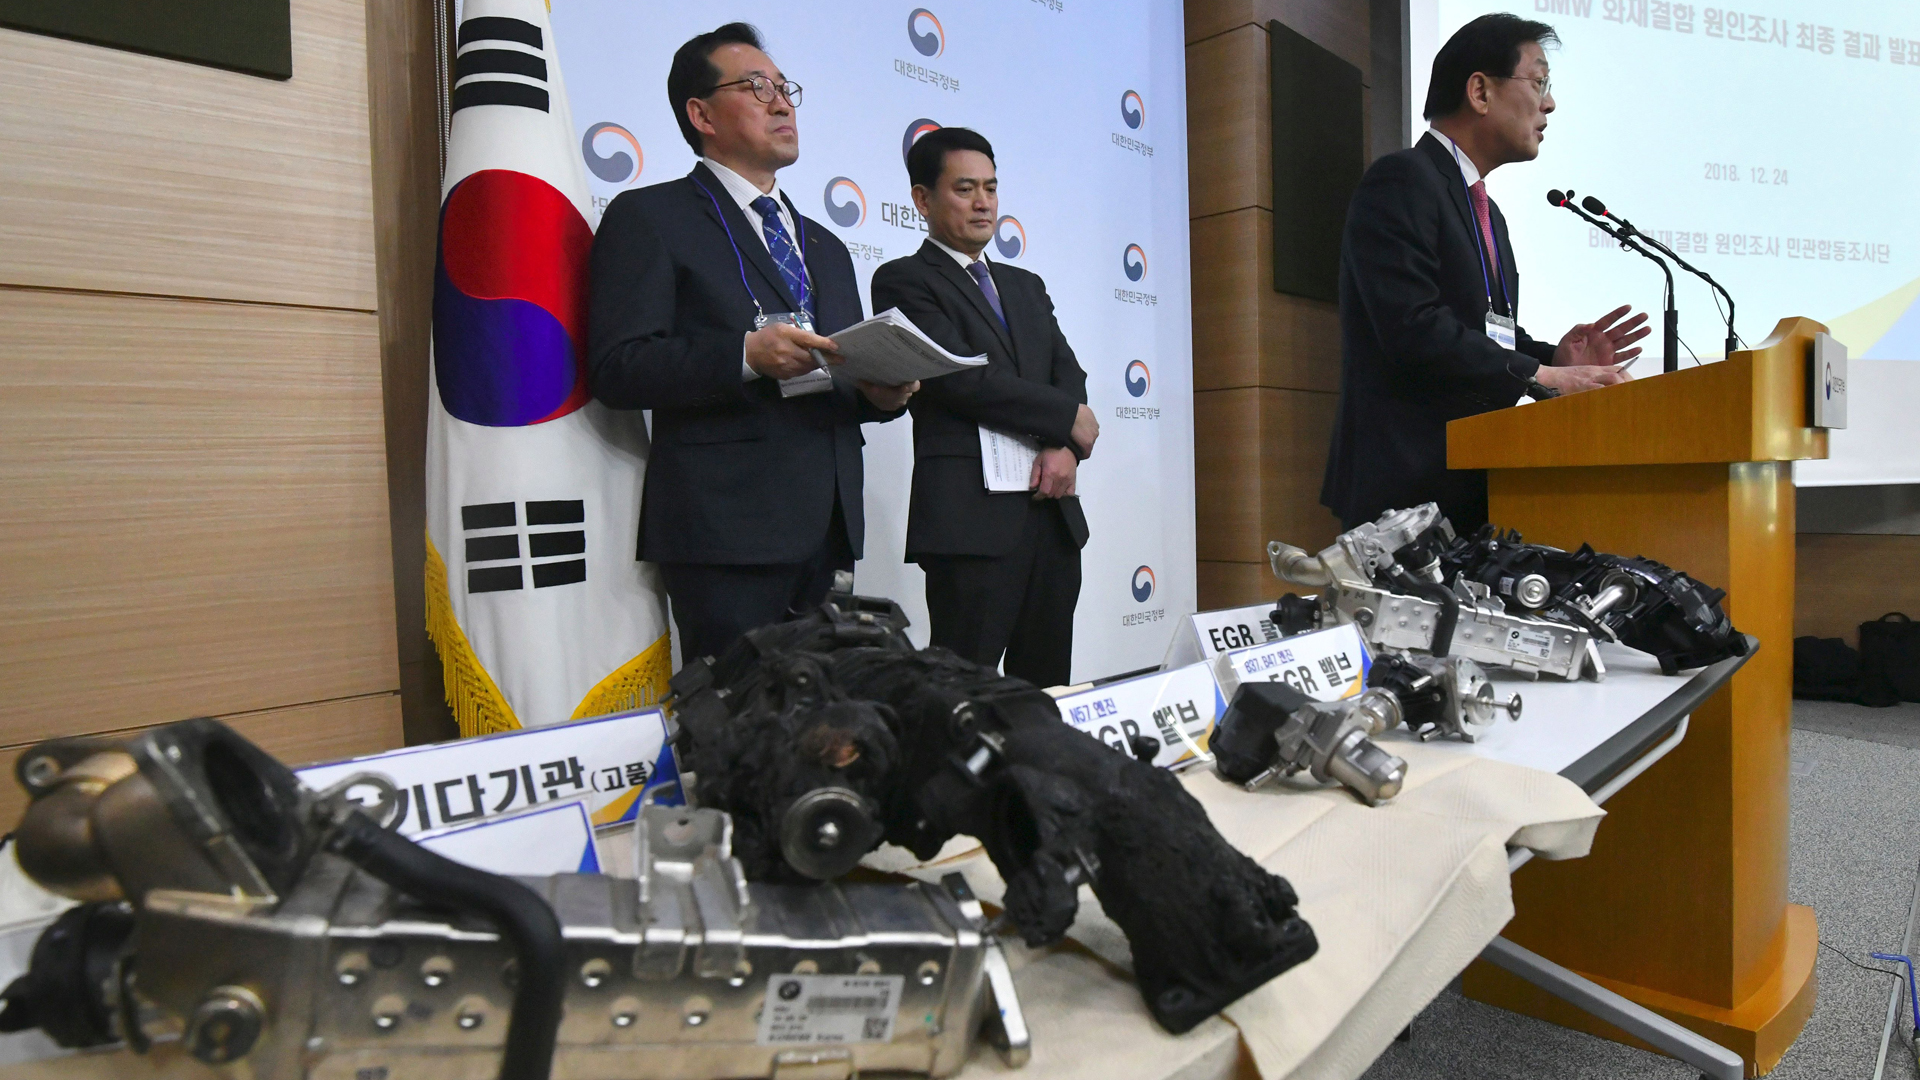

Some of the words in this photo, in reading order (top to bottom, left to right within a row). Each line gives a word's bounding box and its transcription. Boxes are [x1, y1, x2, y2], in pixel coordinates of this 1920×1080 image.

[1602, 0, 1695, 34] 화재결함
[1703, 7, 1789, 48] 원인조사
[1796, 21, 1835, 56] 최종
[1842, 28, 1882, 62] 결과
[893, 58, 960, 93] 대한민국정부
[1111, 132, 1154, 158] 대한민국정부
[1704, 162, 1740, 182] 2018.
[1773, 168, 1789, 186] 24
[843, 241, 884, 262] 국정부
[1588, 227, 1622, 249] BM
[1715, 232, 1781, 257] 원인조사
[1786, 236, 1890, 264] 민관합동조사단
[1114, 288, 1158, 306] 대한민국정부
[1115, 406, 1160, 420] 대한민국정부
[1122, 608, 1165, 627] 대한민국정부
[1208, 623, 1255, 652] EGR
[1277, 648, 1295, 664] 엔진
[1318, 652, 1359, 688] 밸브
[1069, 704, 1092, 724] N57
[1093, 697, 1119, 718] 엔진
[1088, 718, 1141, 757] GR
[1152, 699, 1207, 746] 밸브
